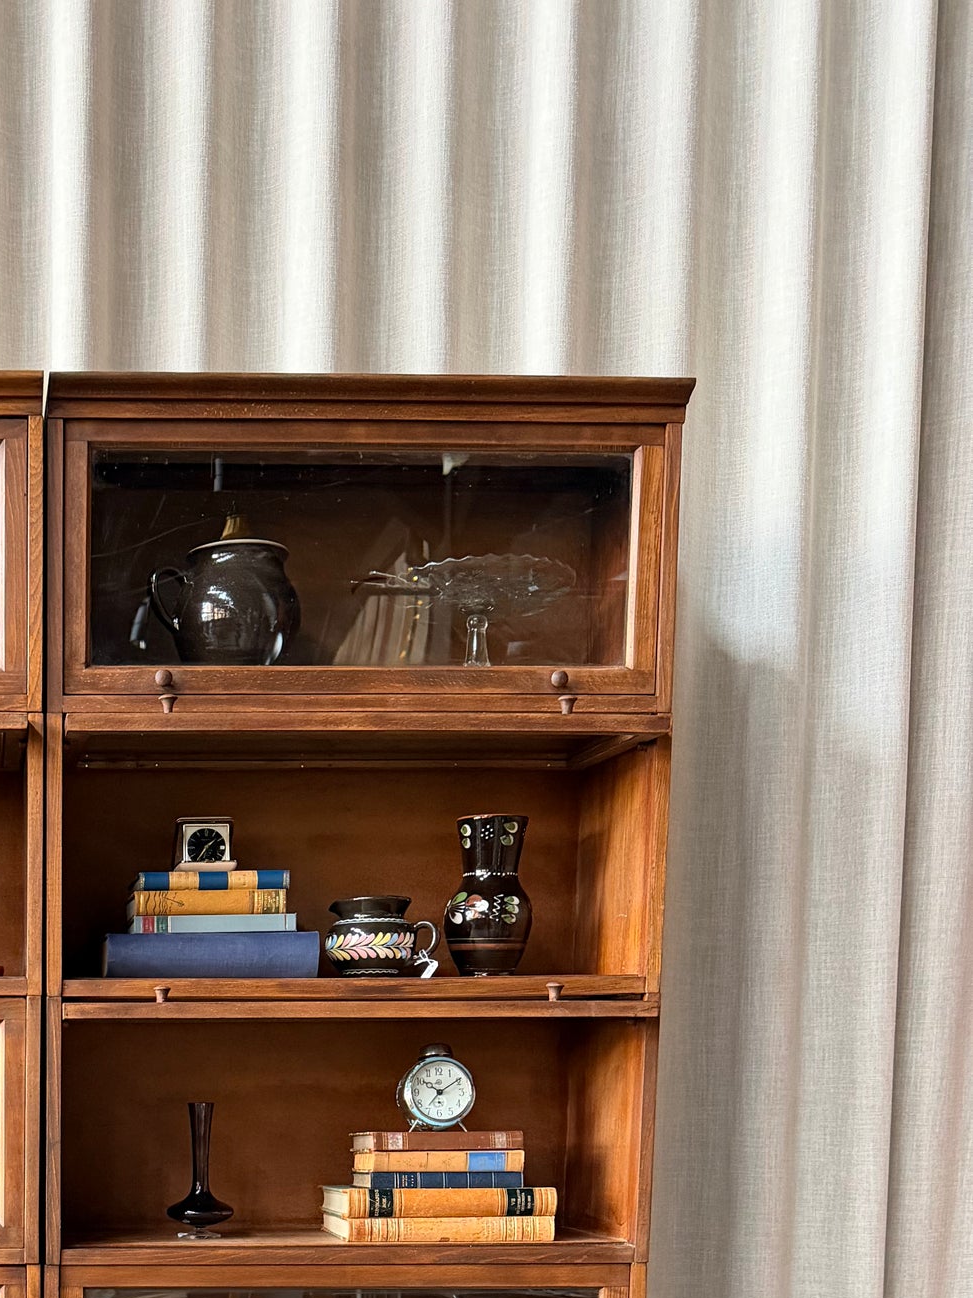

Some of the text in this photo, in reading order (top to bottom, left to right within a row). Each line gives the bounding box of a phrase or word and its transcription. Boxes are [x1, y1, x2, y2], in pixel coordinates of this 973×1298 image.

[425, 1068, 431, 1078] 11
[434, 1067, 443, 1076] 12
[413, 1088, 420, 1097] 9
[458, 1088, 465, 1097] 3
[417, 1099, 423, 1108] 8
[436, 1109, 443, 1118] 6
[448, 1107, 454, 1116] 5
